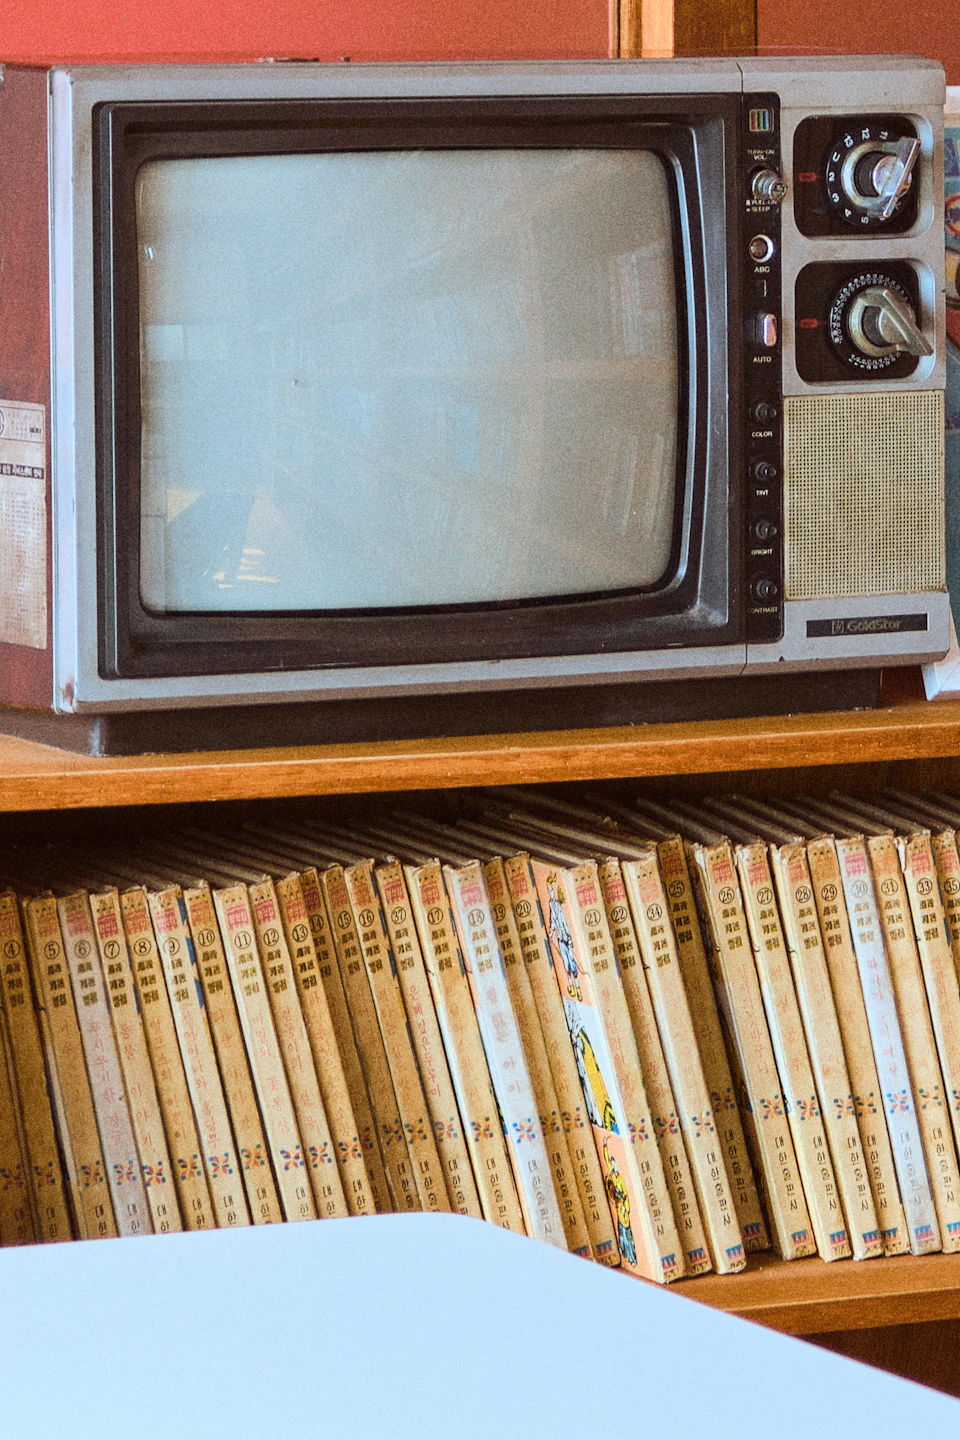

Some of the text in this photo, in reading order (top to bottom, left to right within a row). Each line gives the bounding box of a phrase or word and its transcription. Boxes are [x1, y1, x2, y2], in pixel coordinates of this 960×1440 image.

[861, 128, 871, 140] 12
[843, 135, 854, 148] 13
[828, 172, 835, 182] 2
[832, 192, 840, 203] 3
[844, 208, 852, 217] 4
[847, 618, 903, 632] GoldStar
